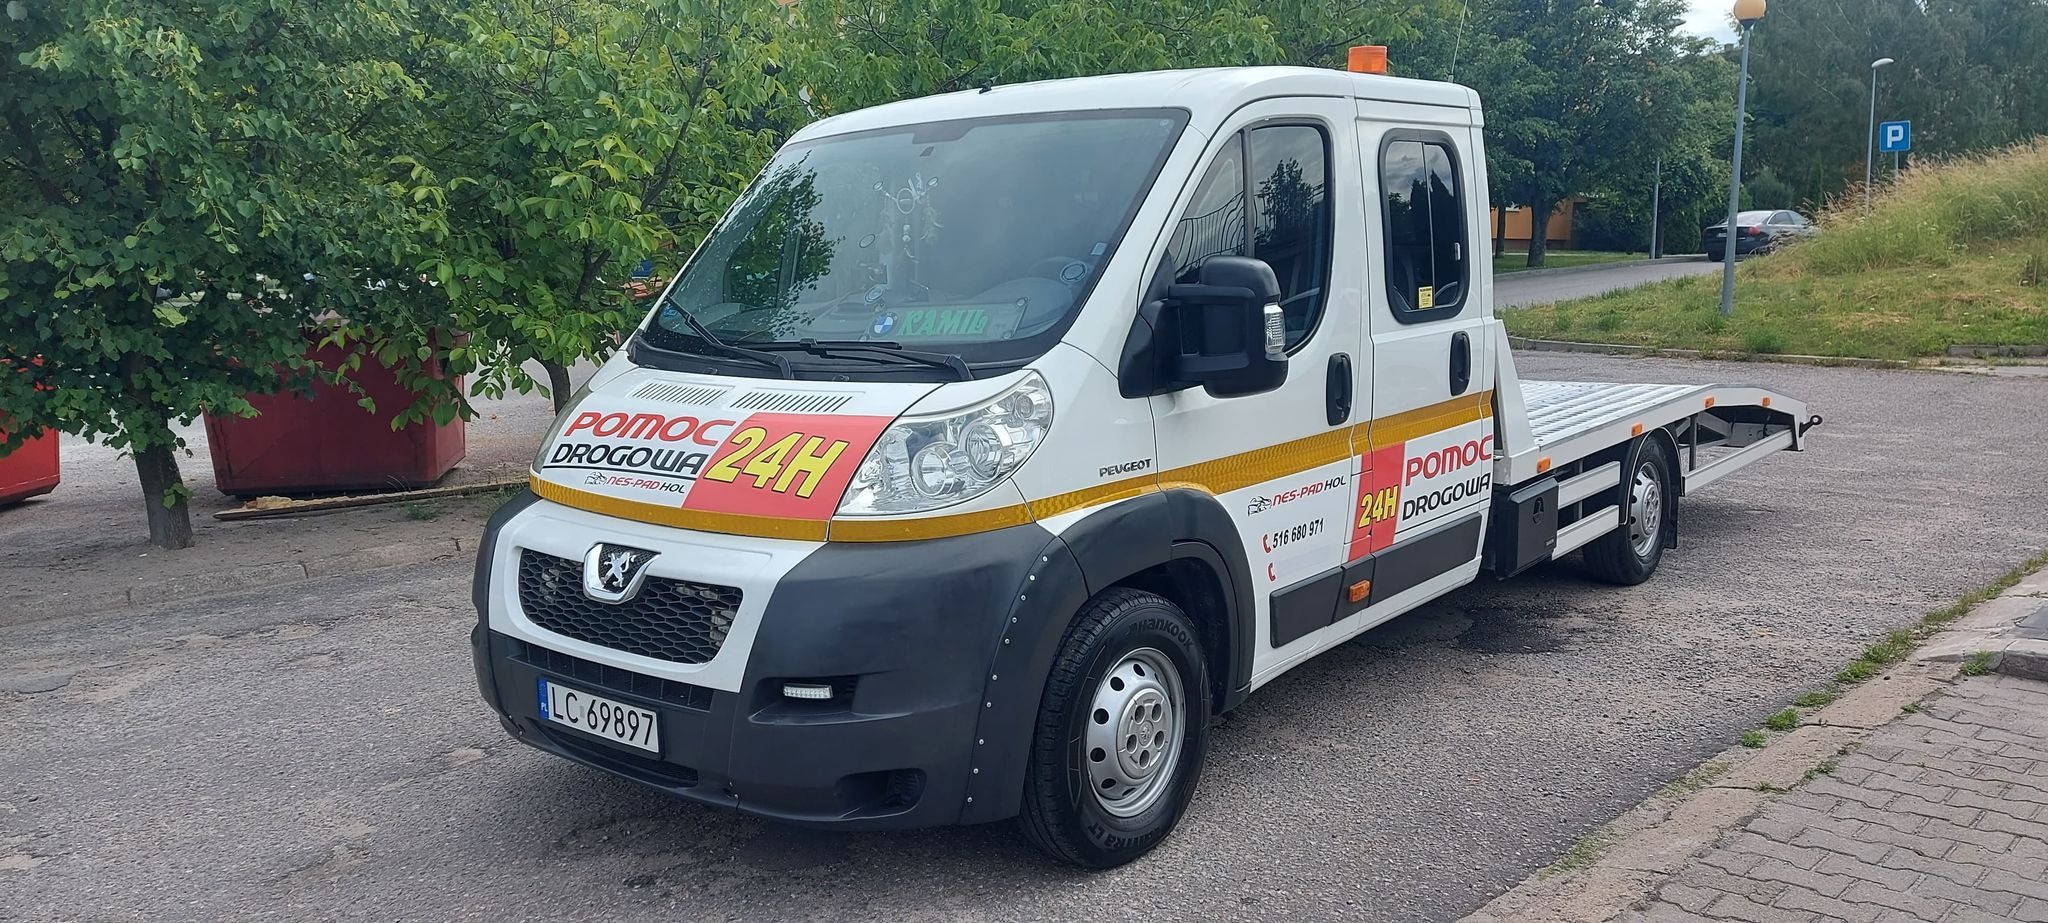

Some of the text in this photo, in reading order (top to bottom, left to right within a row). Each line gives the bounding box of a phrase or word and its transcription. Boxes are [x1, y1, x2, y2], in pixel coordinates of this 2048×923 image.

[1887, 125, 1903, 148] P
[896, 309, 988, 336] KAMIL
[564, 412, 736, 446] POMOC
[550, 443, 709, 475] DROGOWA
[703, 426, 850, 499] 24H
[1099, 458, 1152, 477] PEUGEOT
[1405, 435, 1493, 487] POMOC
[607, 476, 685, 494] NES-PAD HOL
[1272, 476, 1347, 507] NES-PAD HOL
[1402, 472, 1491, 521] DROGOWA
[1358, 484, 1399, 529] 24H
[1272, 518, 1324, 549] 516 680 971
[540, 702, 548, 712] PL
[551, 686, 653, 745] LC 69897
